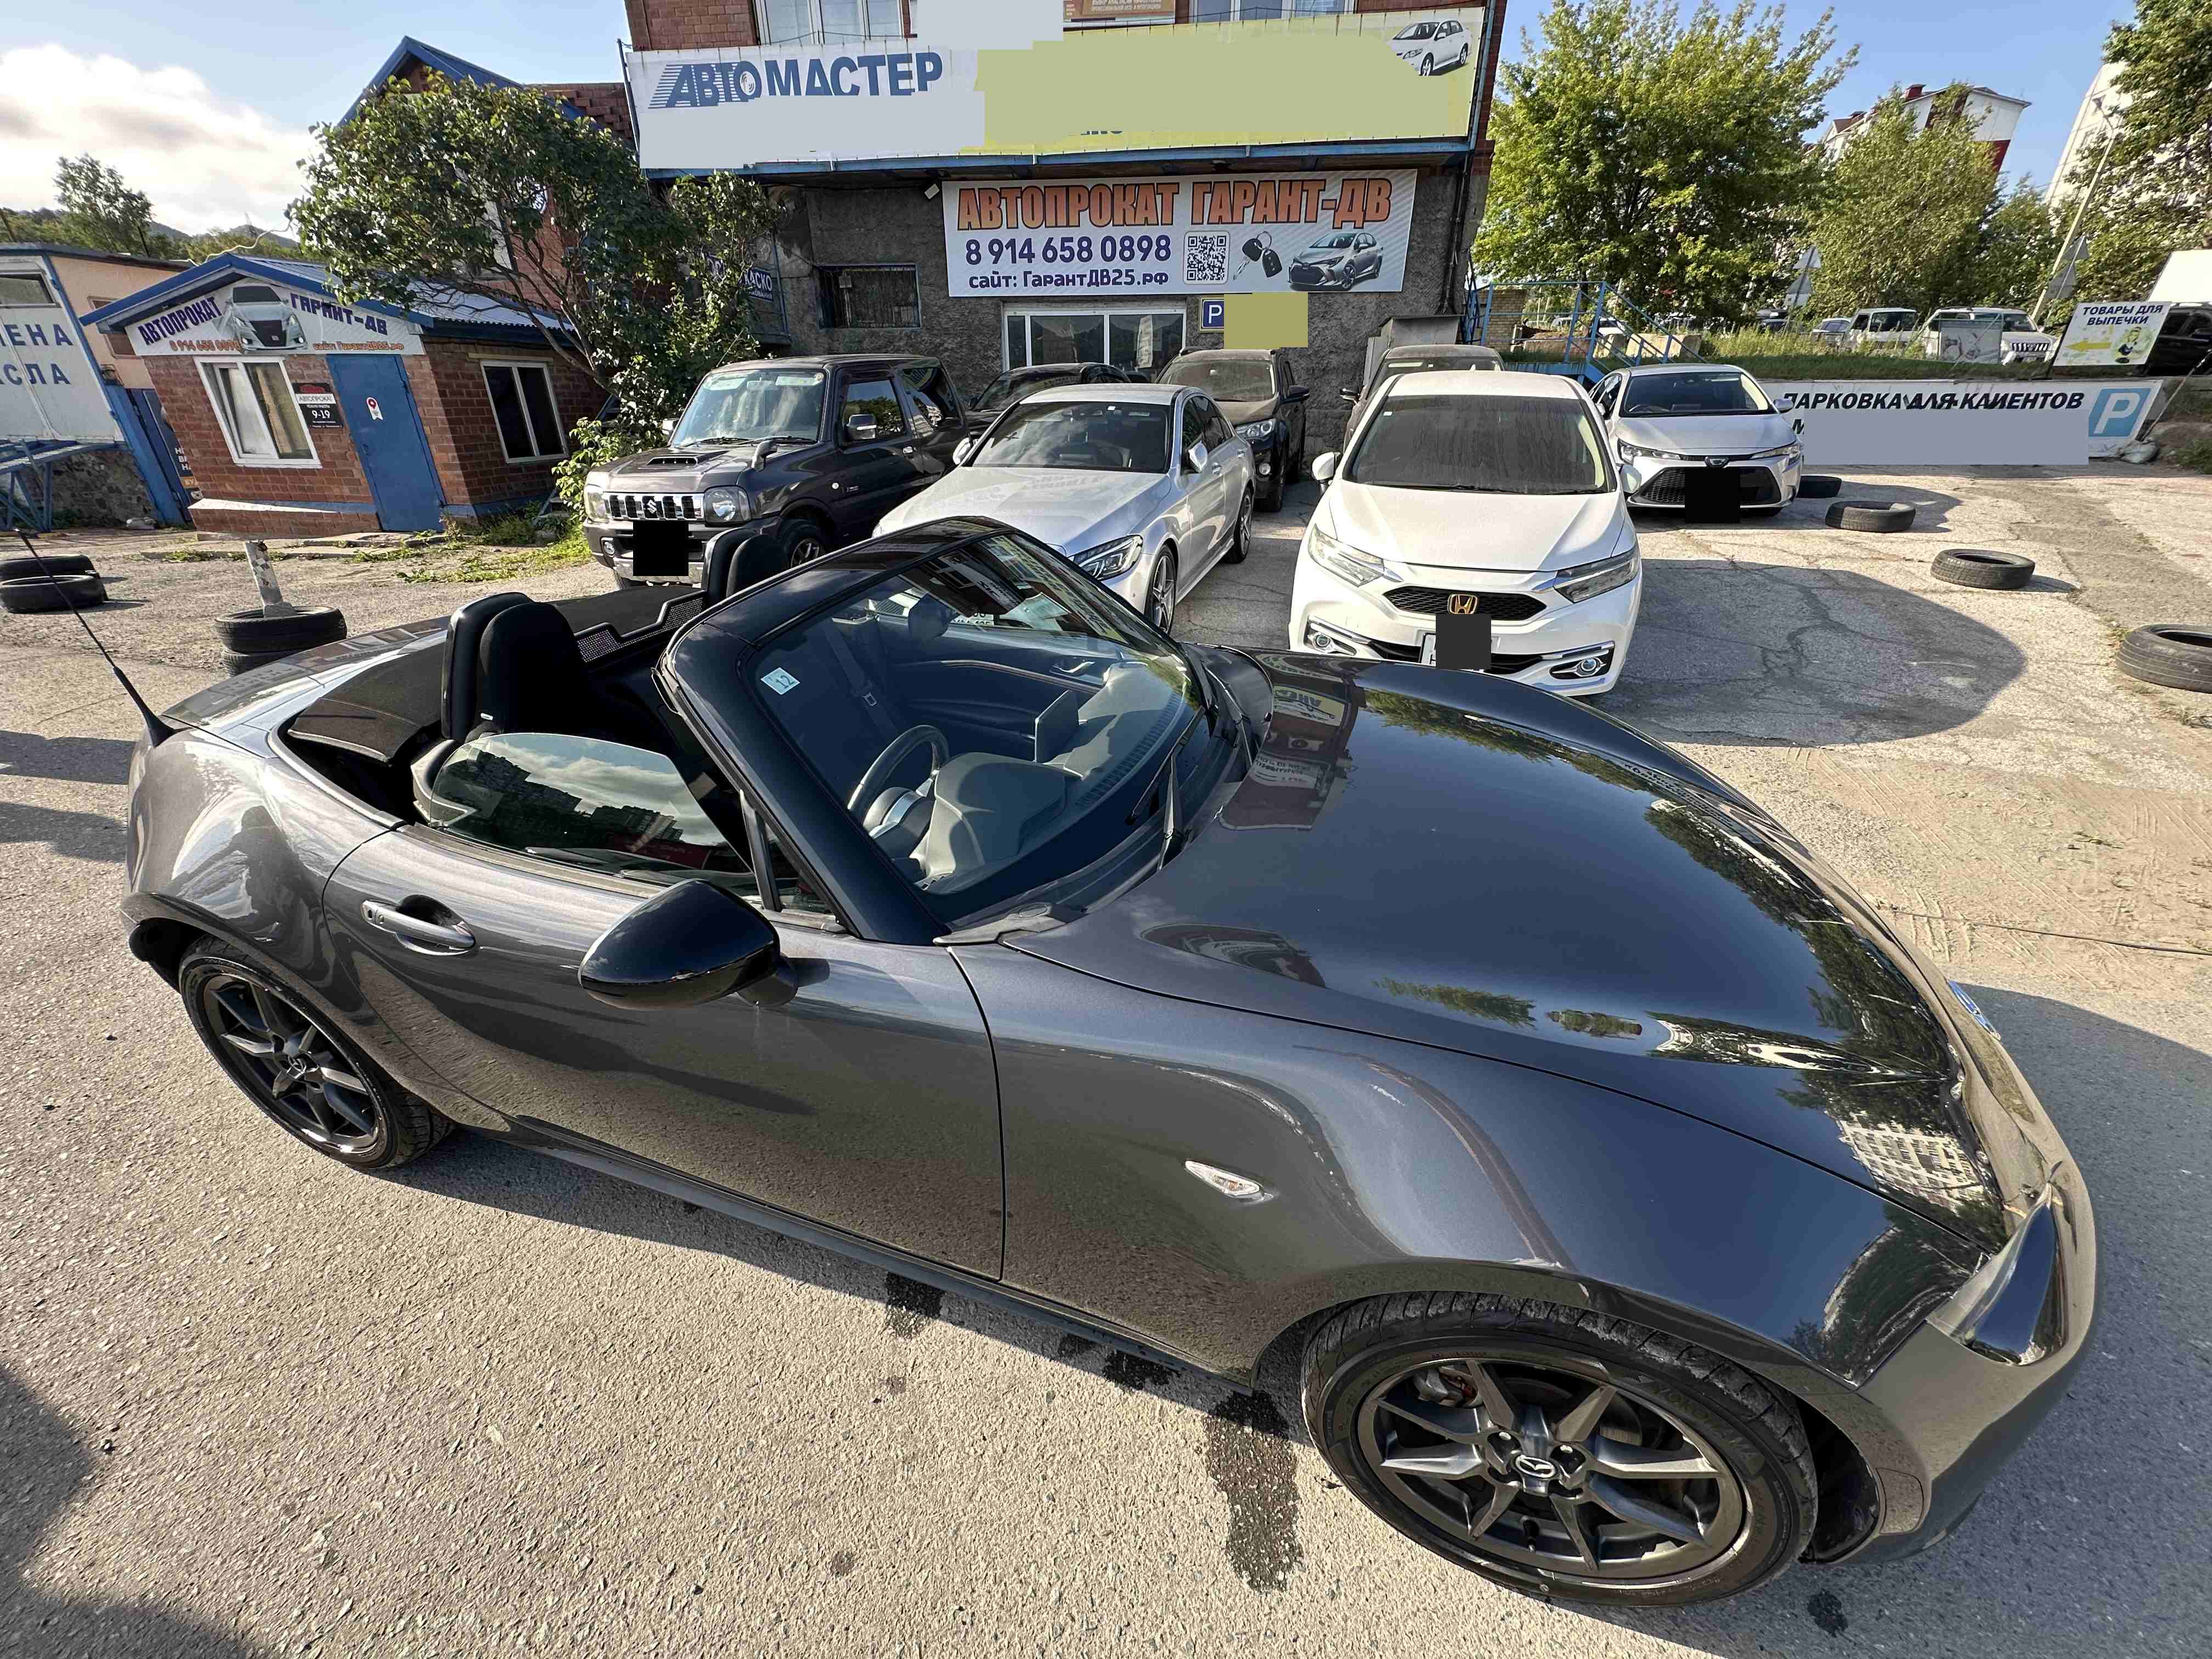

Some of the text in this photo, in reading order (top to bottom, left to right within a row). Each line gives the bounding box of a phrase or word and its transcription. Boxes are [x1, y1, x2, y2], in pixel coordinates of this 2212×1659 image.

[957, 178, 1392, 230] АВТОПРОКАТ ГАРАНТ-ДВ
[966, 235, 1171, 265] 8 914 658 0898
[969, 268, 1169, 288] сайт: ГарантДВ25.рф
[138, 293, 387, 345] АВТОПРОКАТ ГАРАНТ-ДВ
[1209, 304, 1223, 324] P
[2084, 304, 2164, 315] ТОВАРЫ ДЛЯ
[2086, 316, 2149, 325] ВЫПЕЧКИ
[0, 324, 74, 347] ЕНА
[0, 363, 71, 385] СЛА
[312, 410, 330, 419] 9-19
[2093, 387, 2140, 433] P
